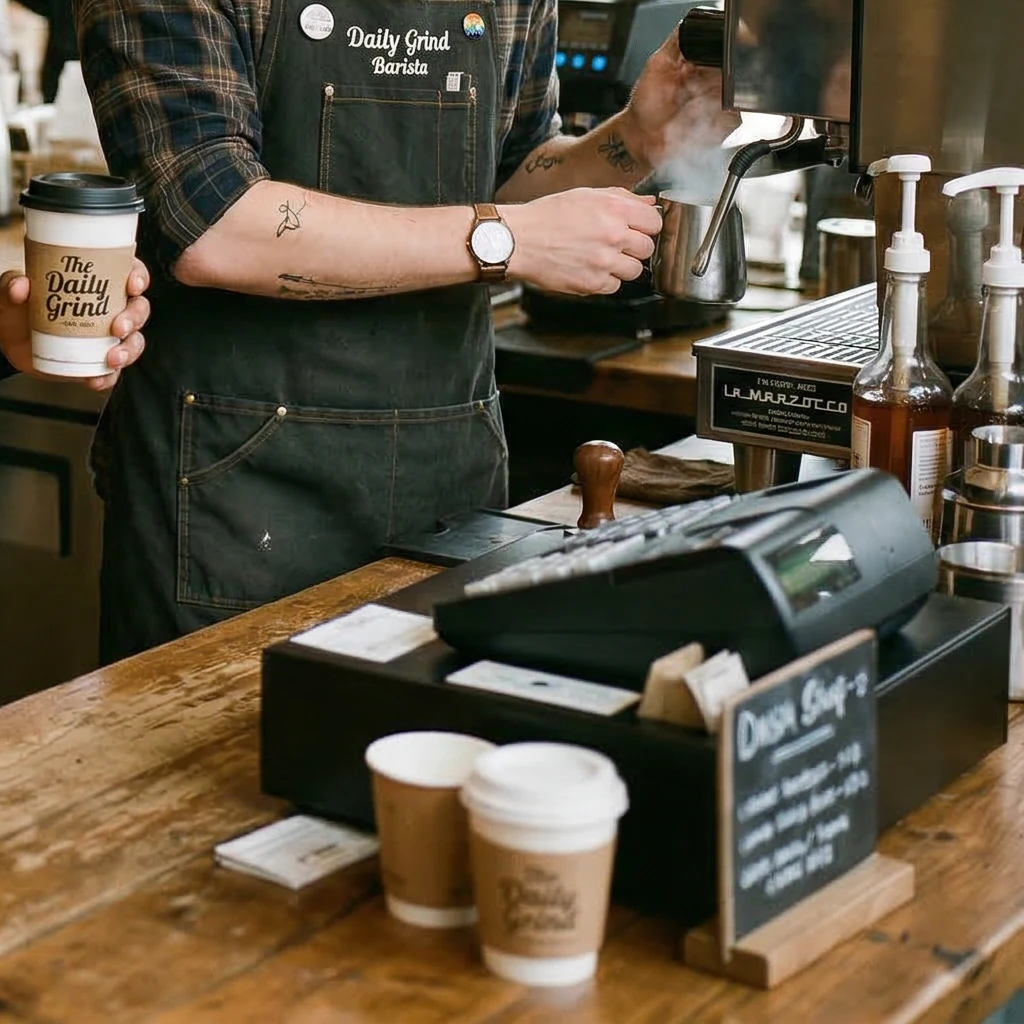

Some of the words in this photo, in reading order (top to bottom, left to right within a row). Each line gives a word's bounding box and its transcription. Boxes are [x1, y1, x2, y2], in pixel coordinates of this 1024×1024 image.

[346, 25, 401, 57] Daily
[405, 29, 451, 56] Grind
[371, 56, 429, 75] Barista
[60, 255, 94, 274] The
[45, 271, 110, 301] Daily
[45, 294, 110, 322] Grind
